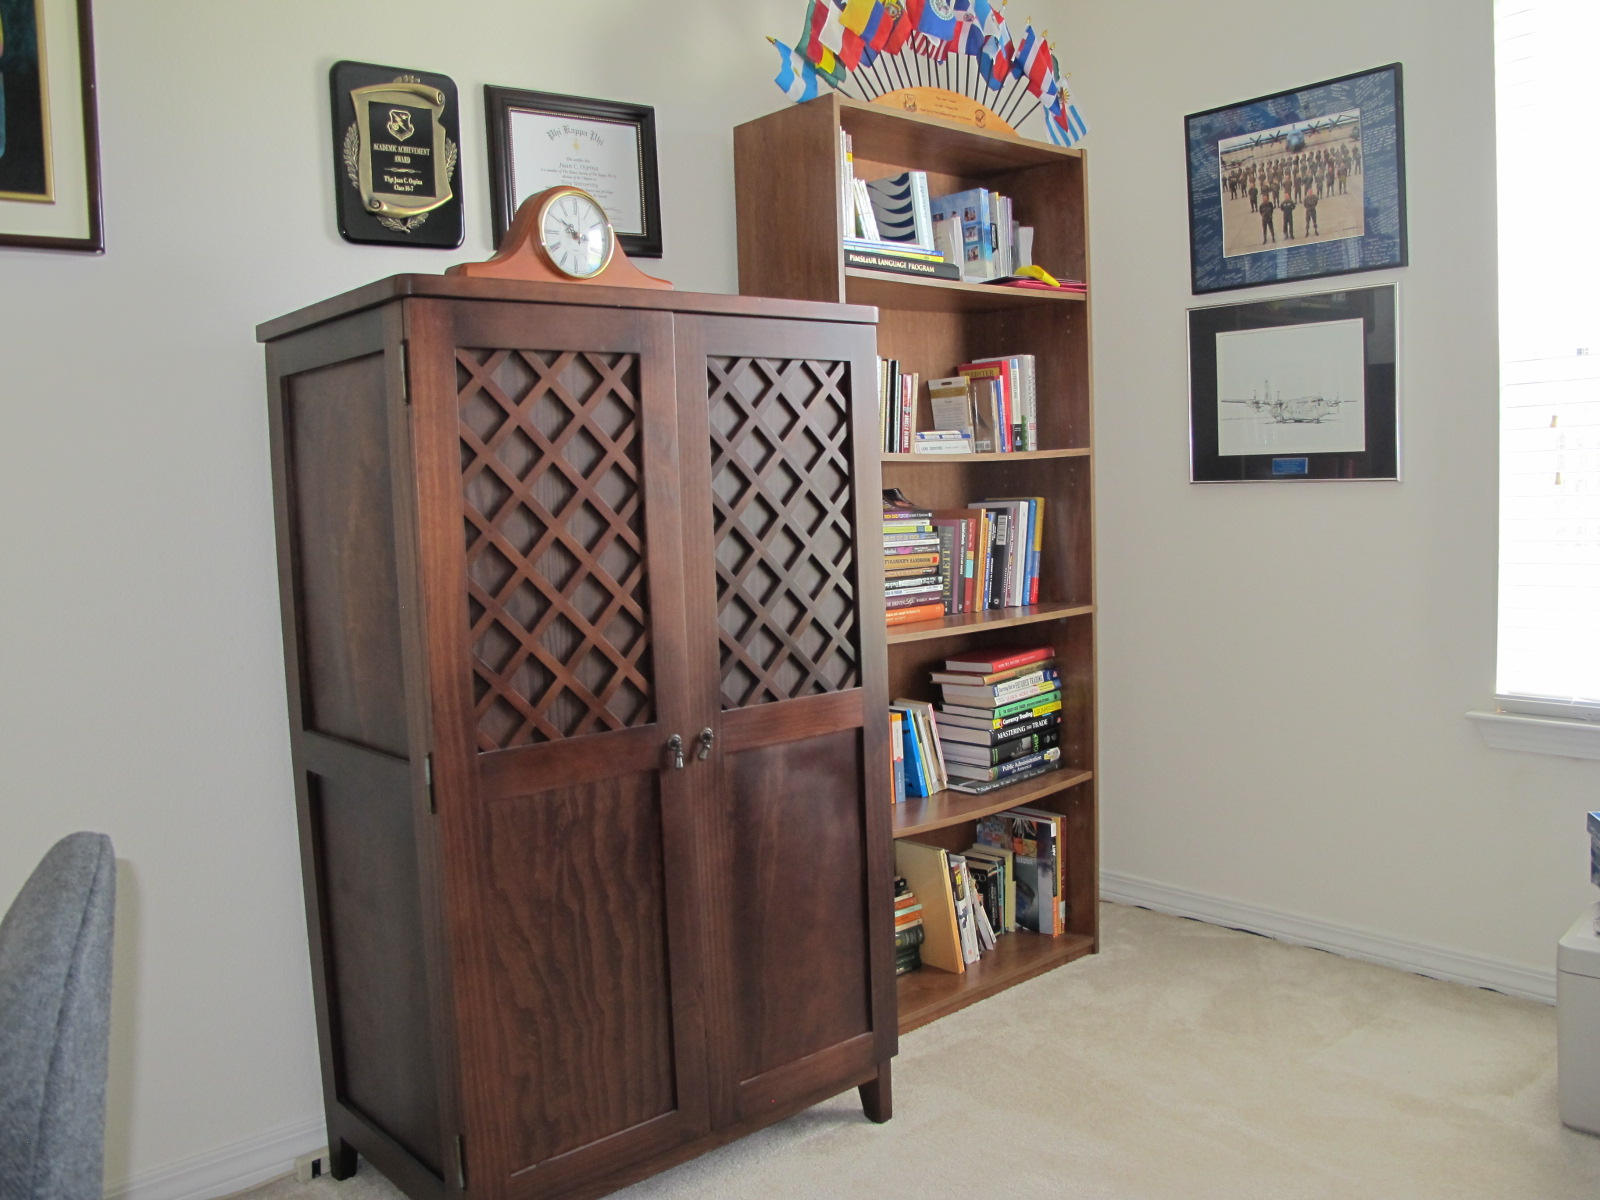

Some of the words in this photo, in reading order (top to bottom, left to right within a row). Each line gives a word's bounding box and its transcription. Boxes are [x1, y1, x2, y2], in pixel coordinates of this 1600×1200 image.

[373, 143, 397, 152] ACADEMIC
[398, 145, 430, 156] ACHIEVEMENT
[395, 155, 410, 164] AWARD
[878, 258, 907, 269] LANGUAGE
[908, 262, 935, 273] PROGRAM
[1002, 716, 1019, 725] Currency
[1019, 711, 1033, 720] Trading
[997, 726, 1026, 740] MASTERING
[1032, 719, 1048, 729] TRADE
[1002, 763, 1015, 772] Public
[1014, 755, 1042, 767] Administration
